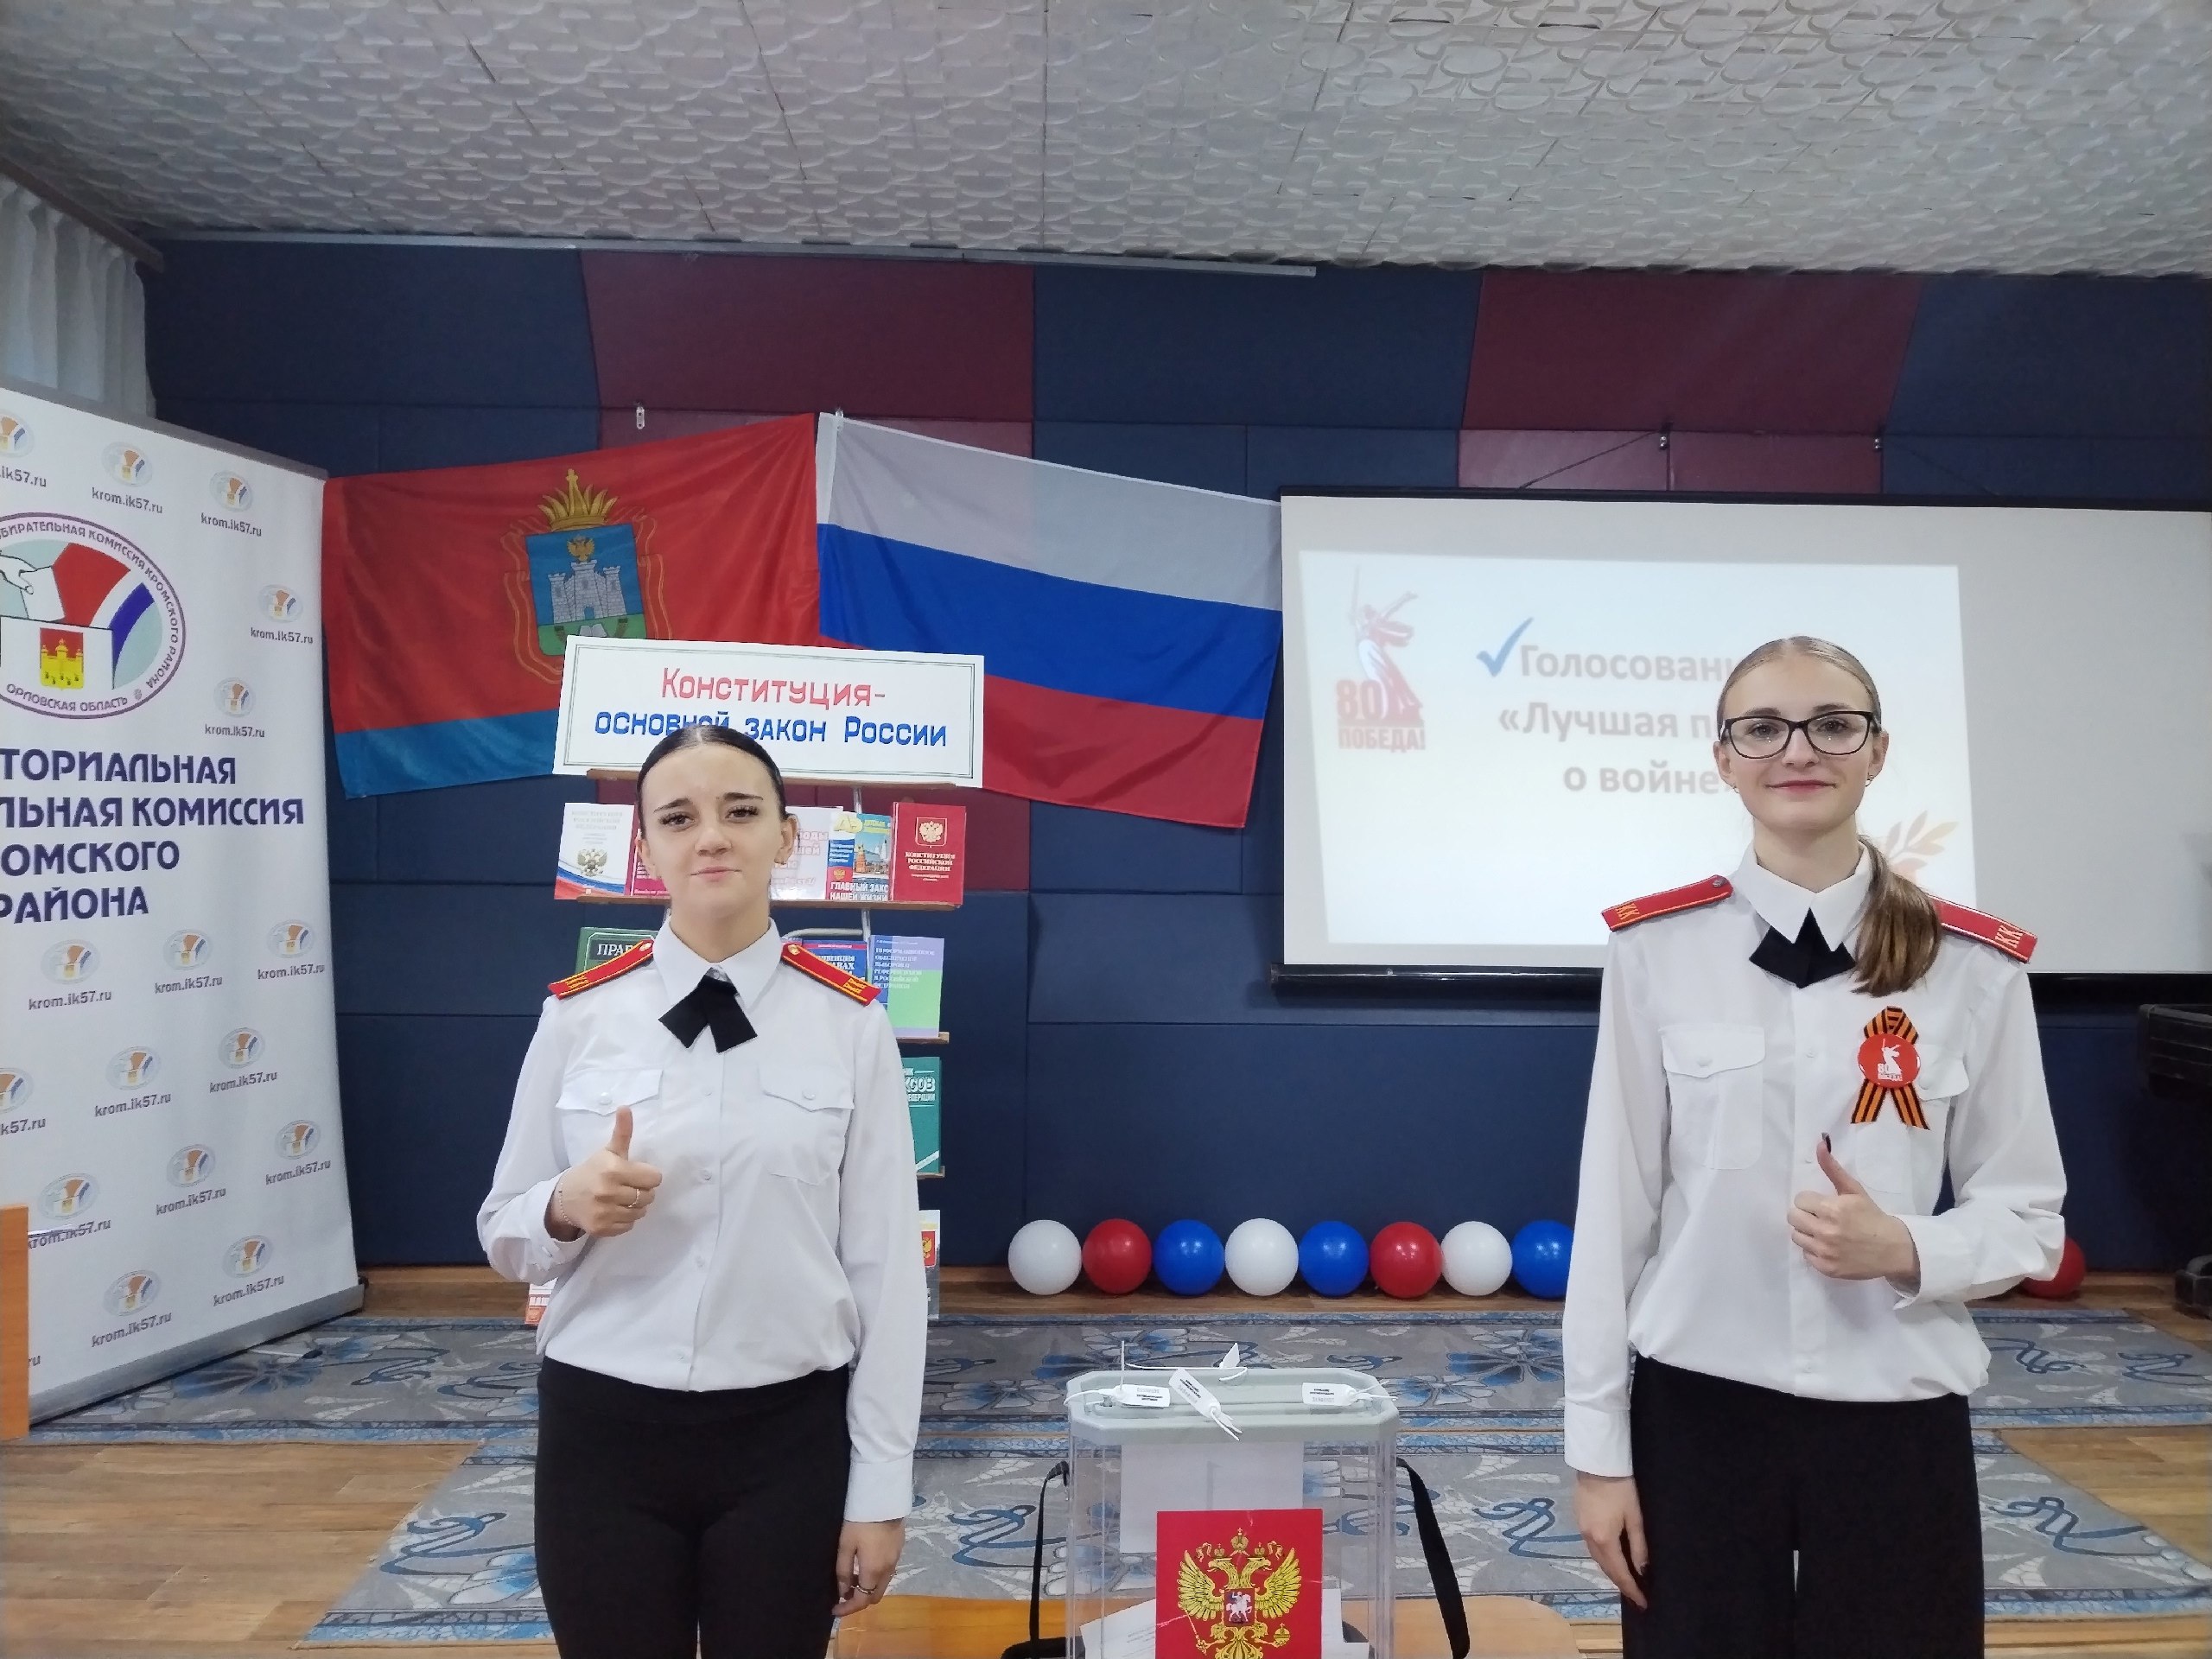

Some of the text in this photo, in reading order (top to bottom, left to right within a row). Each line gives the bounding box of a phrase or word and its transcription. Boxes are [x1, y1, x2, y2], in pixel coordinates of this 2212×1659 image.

[92, 487, 163, 514] krom.ik57.ru
[201, 512, 263, 537] krom.ik57.ru
[0, 521, 179, 690] БИРАТЕЛЬНАЯ КОМИССИЯ КРОМСКОГО РАЙОНА
[251, 627, 314, 645] krom.ik57.ru
[6, 683, 128, 712] ОРЛОВСКАЯ ОБЛАСТЬ
[205, 723, 264, 738] krom.ik57.ru
[1498, 702, 1717, 742] «Лучшая п
[1338, 727, 1426, 753] ПОБЕДА!
[0, 748, 236, 785] ТОРИАЛЬНАЯ
[1563, 766, 1587, 792] о
[132, 798, 304, 827] КОМИССИЯ
[0, 840, 180, 876] ОМСКОГО
[155, 975, 223, 994] krom.ik57.ru
[257, 963, 325, 980] krom.ik57.ru
[29, 990, 111, 1010] krom.ik57.ru
[209, 1071, 277, 1093] krom.ik57.ru
[94, 1092, 172, 1117] krom.ik57.ru
[265, 1160, 331, 1185] krom.ik57.ru
[156, 1186, 226, 1216] krom.ik57.ru
[213, 1274, 284, 1307] krom.ik57.ru
[92, 1312, 172, 1348] krom.ik57.ru
